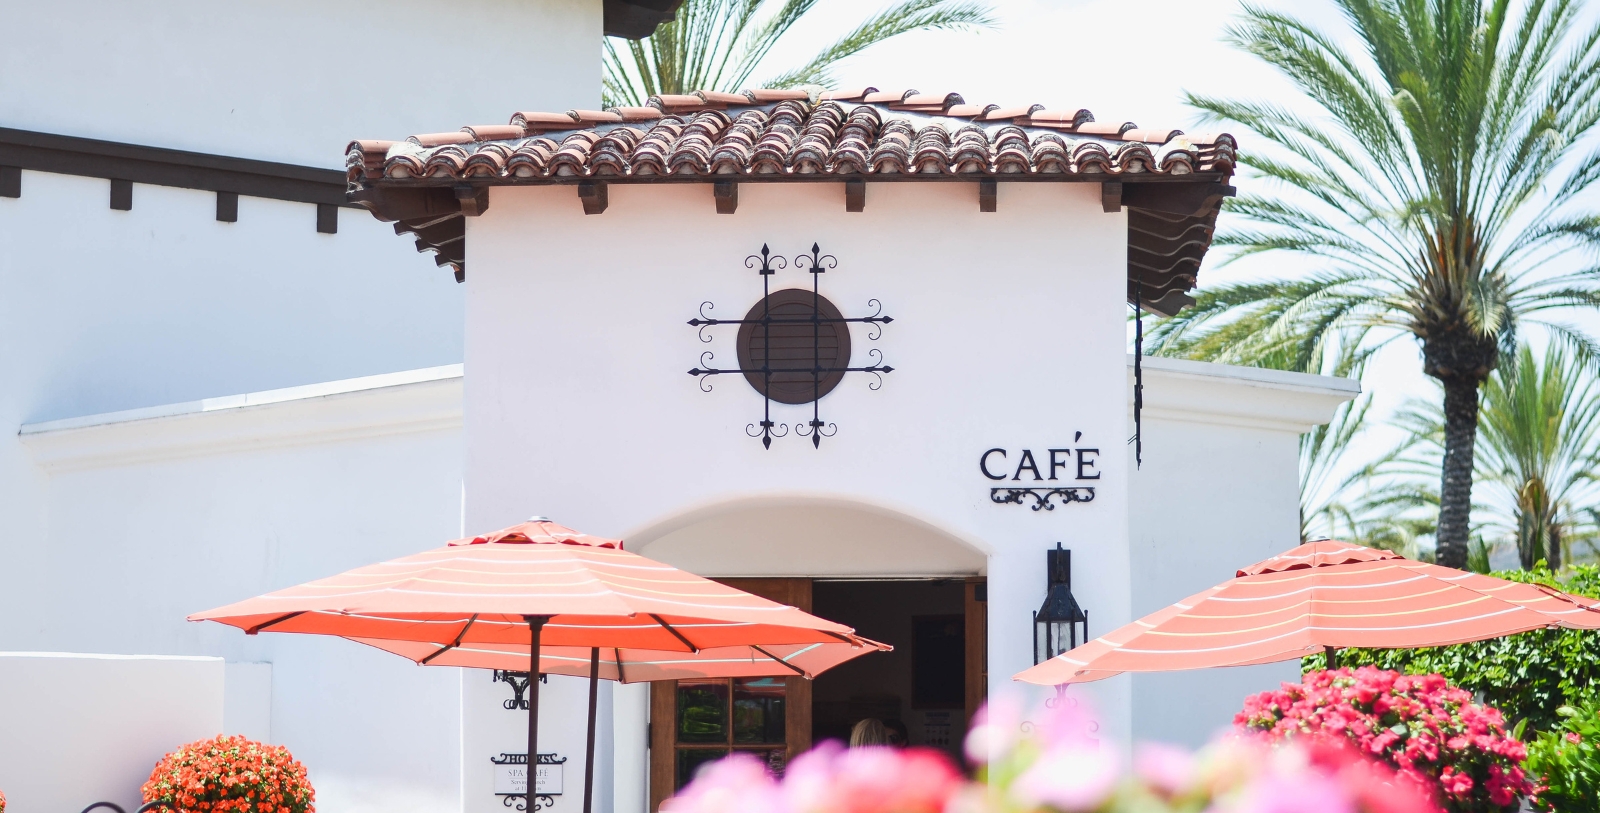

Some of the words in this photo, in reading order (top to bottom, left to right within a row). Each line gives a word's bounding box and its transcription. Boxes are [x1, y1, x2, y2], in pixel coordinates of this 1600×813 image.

[980, 431, 1101, 480] CAFÉ
[509, 755, 550, 763] HORS
[508, 769, 524, 777] SPA
